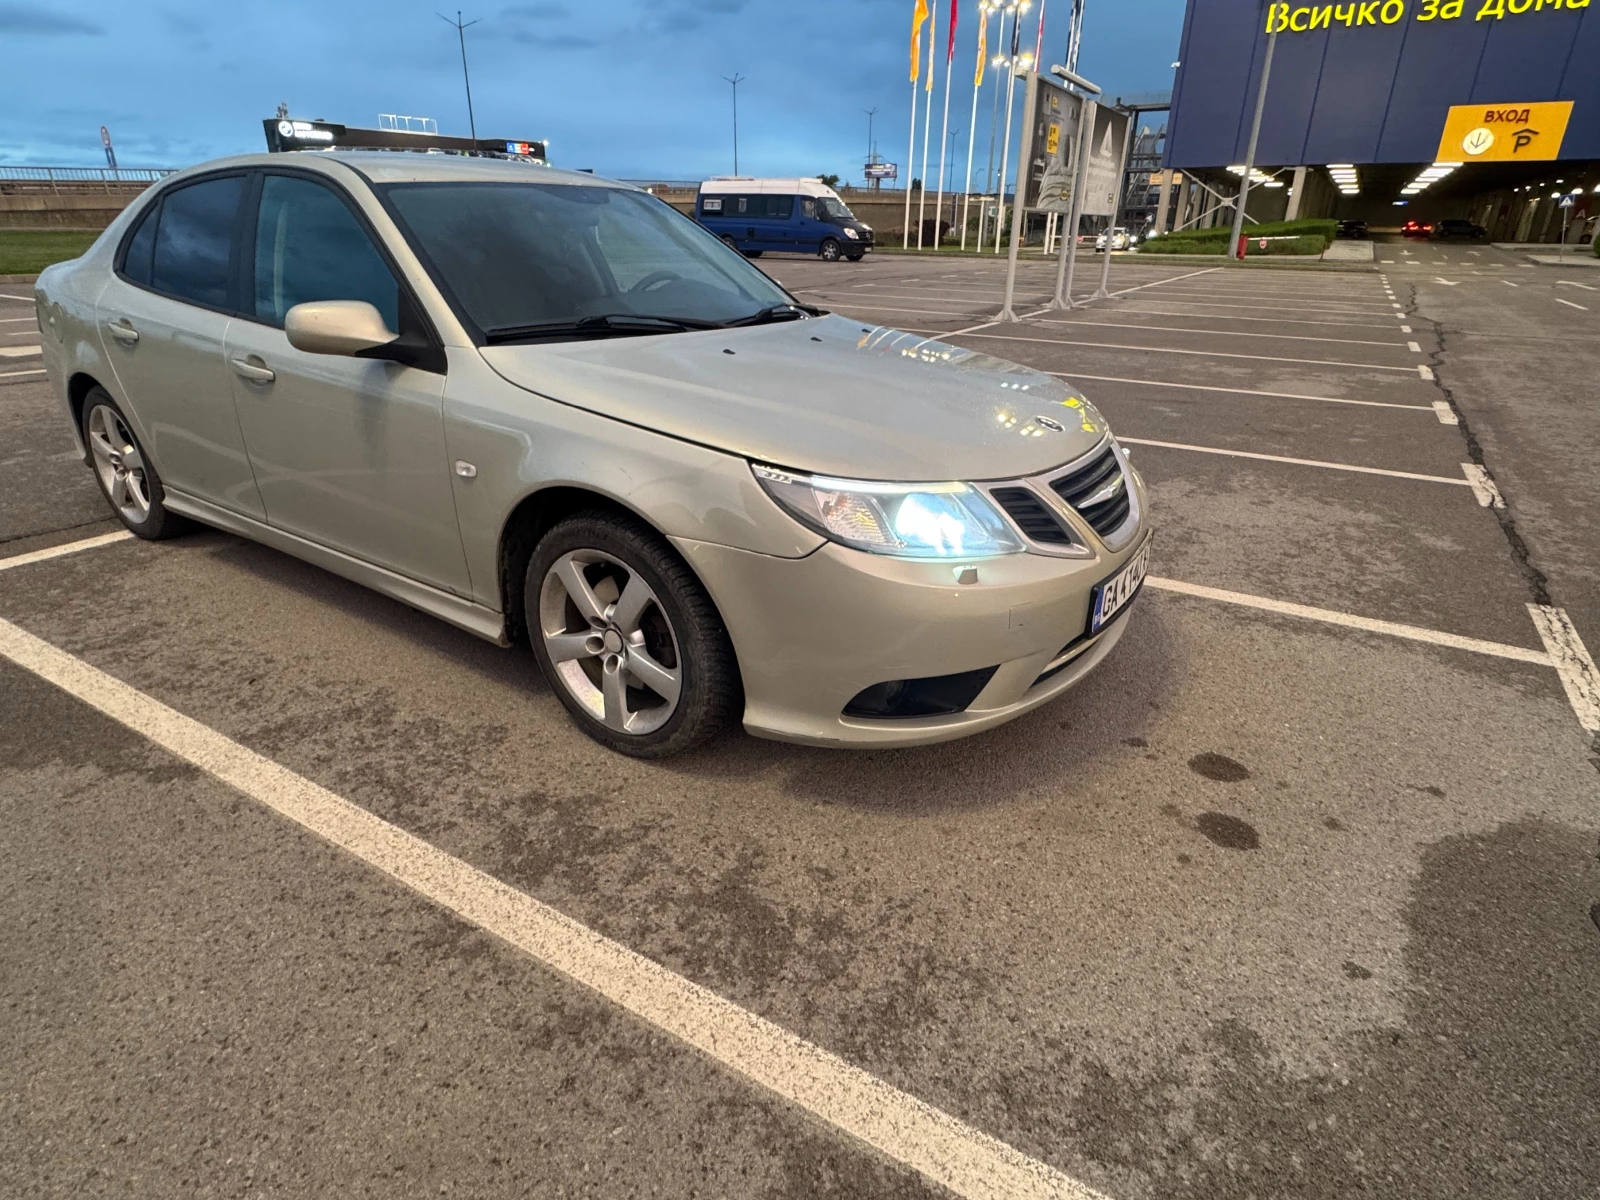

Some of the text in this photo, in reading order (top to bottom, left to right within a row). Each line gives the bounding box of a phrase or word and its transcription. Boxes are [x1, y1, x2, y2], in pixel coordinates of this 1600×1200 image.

[1265, 0, 1591, 34] Всичко за до
[1484, 108, 1531, 124] ВХОД
[1513, 135, 1532, 153] P
